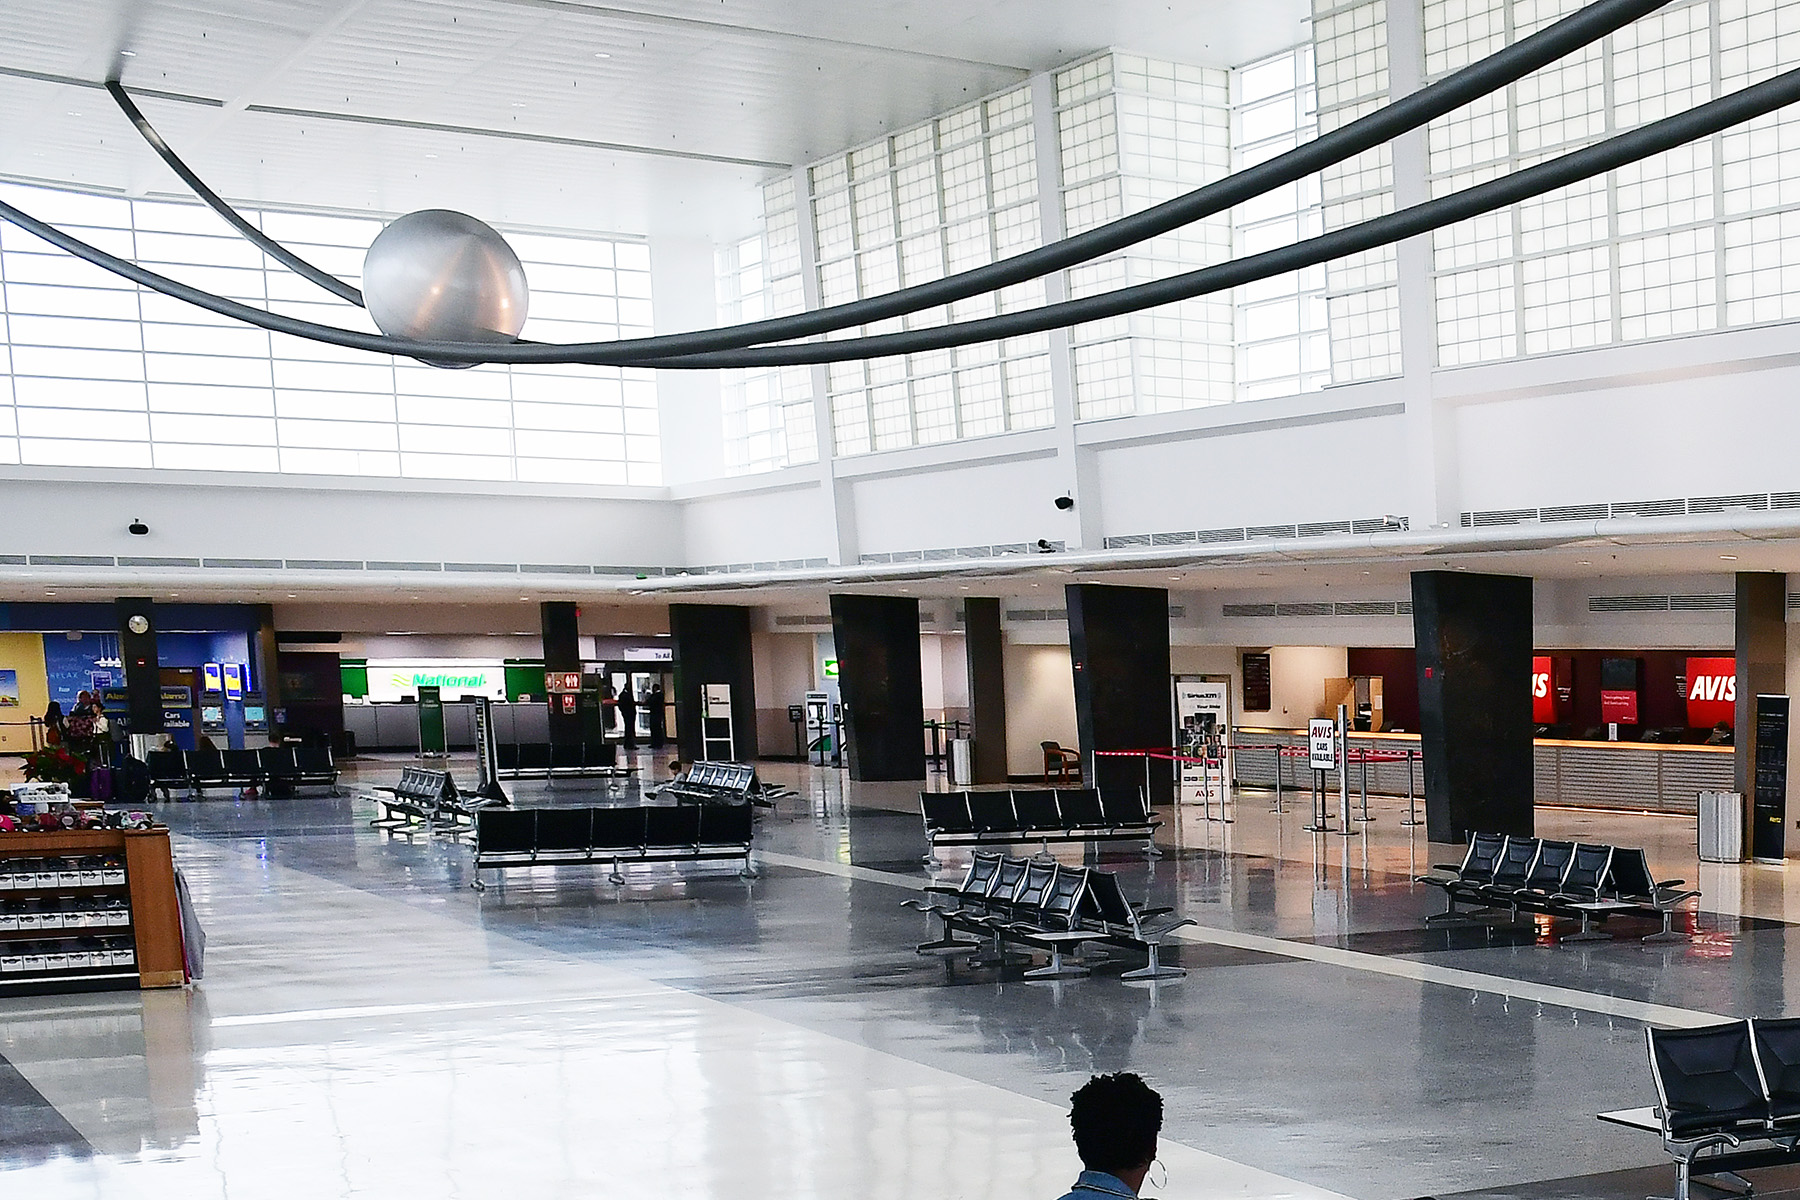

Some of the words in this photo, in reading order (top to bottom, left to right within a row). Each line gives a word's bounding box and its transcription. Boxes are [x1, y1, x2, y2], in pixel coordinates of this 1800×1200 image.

[412, 673, 485, 688] National
[1689, 675, 1737, 702] AVIS
[1311, 726, 1333, 739] AVIS
[1316, 742, 1328, 751] CARS
